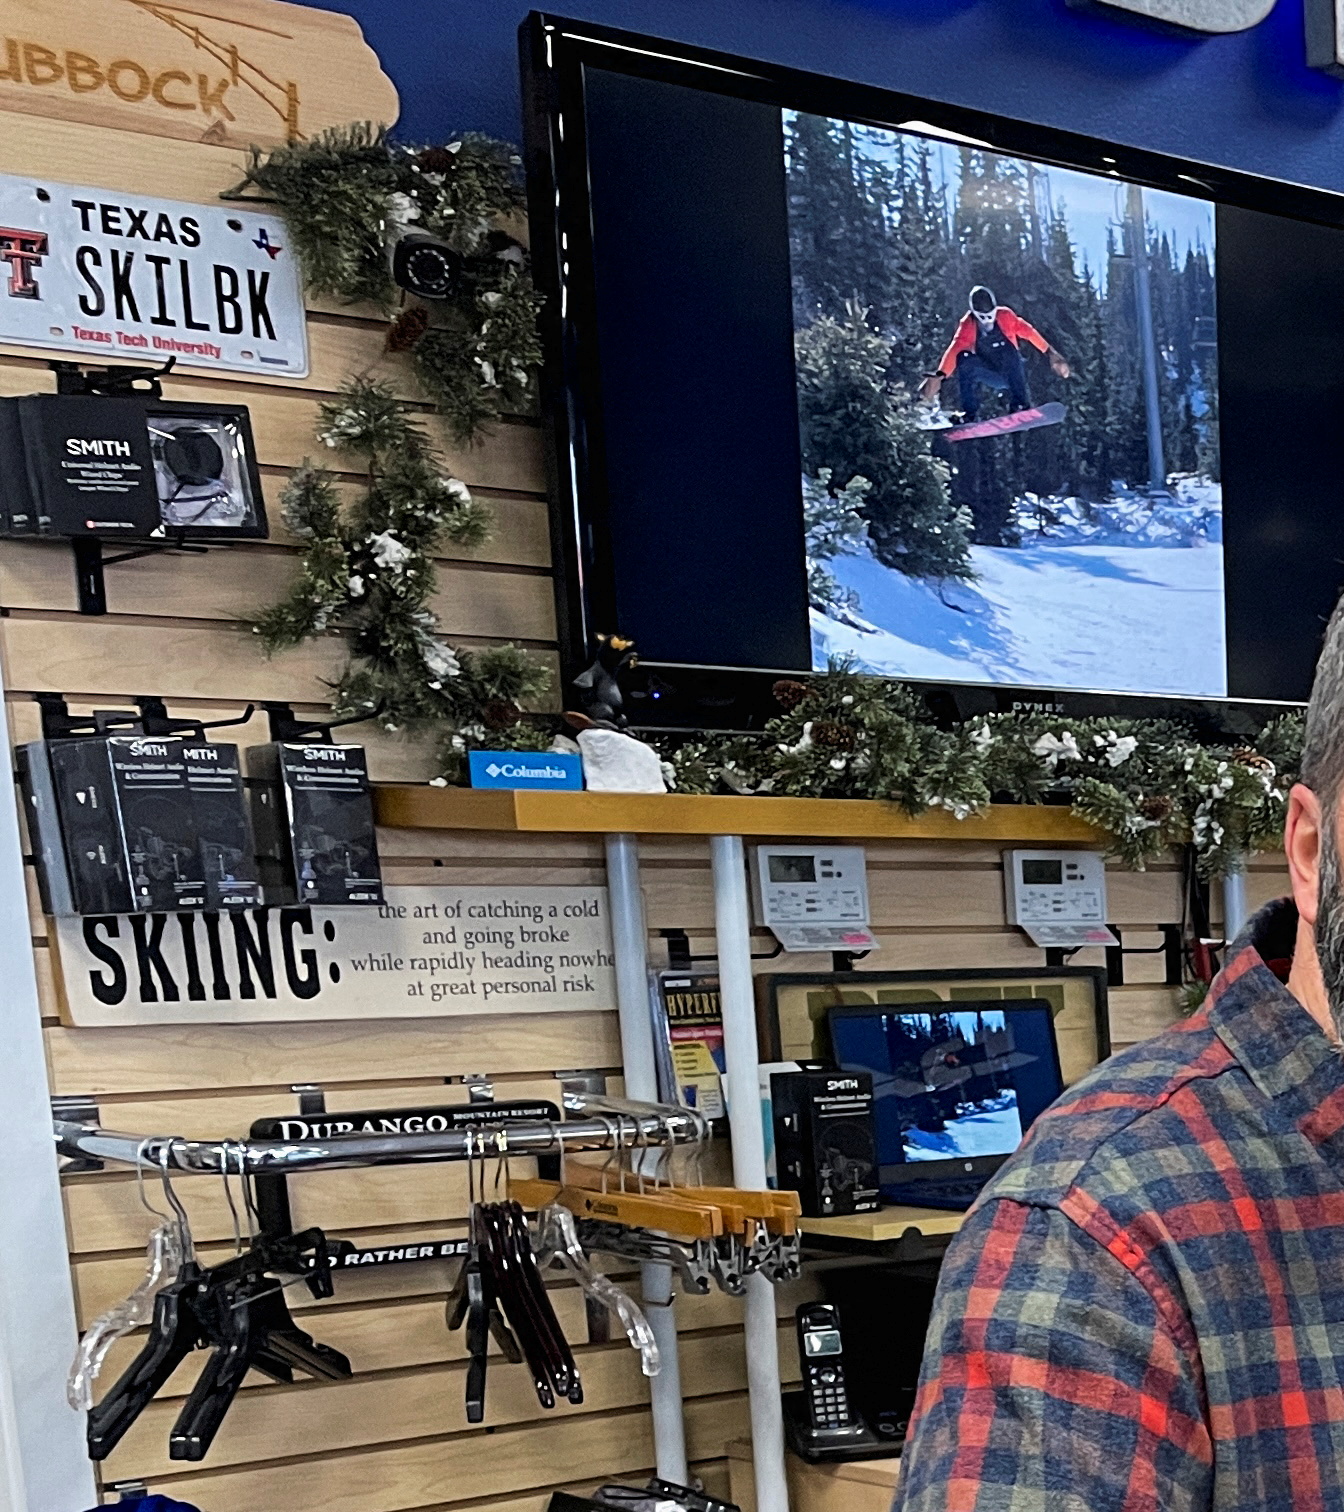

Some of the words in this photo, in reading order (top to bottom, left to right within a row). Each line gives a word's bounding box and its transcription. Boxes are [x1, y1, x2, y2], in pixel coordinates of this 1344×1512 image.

[71, 199, 202, 248] TEXAS
[75, 245, 278, 341] SKILBK
[71, 325, 112, 344] Texas
[115, 330, 149, 348] Tech
[151, 335, 222, 359] University
[66, 438, 131, 457] SMITH
[1012, 701, 1066, 714] DYNEX
[129, 741, 168, 758] SMITH
[183, 747, 218, 762] MITH
[304, 747, 346, 762] SMITH
[501, 763, 567, 779] Columbia
[378, 902, 407, 919] the
[413, 901, 438, 919] art
[444, 899, 463, 918] of
[467, 899, 544, 924] catching
[548, 904, 558, 918] a
[563, 899, 600, 918] cold
[422, 925, 458, 944] and
[463, 926, 515, 950] going
[519, 925, 570, 943] broke
[82, 907, 341, 1006] SKIING:
[351, 952, 404, 972] while
[409, 951, 476, 976] rapidly
[482, 950, 554, 974] heading
[407, 980, 425, 997] at
[430, 980, 477, 1002] great
[482, 974, 557, 1000] personal
[562, 973, 595, 993] risk
[827, 1078, 859, 1091] SMITH
[278, 1113, 448, 1143] DURANGO
[344, 1244, 434, 1267] RATHER
